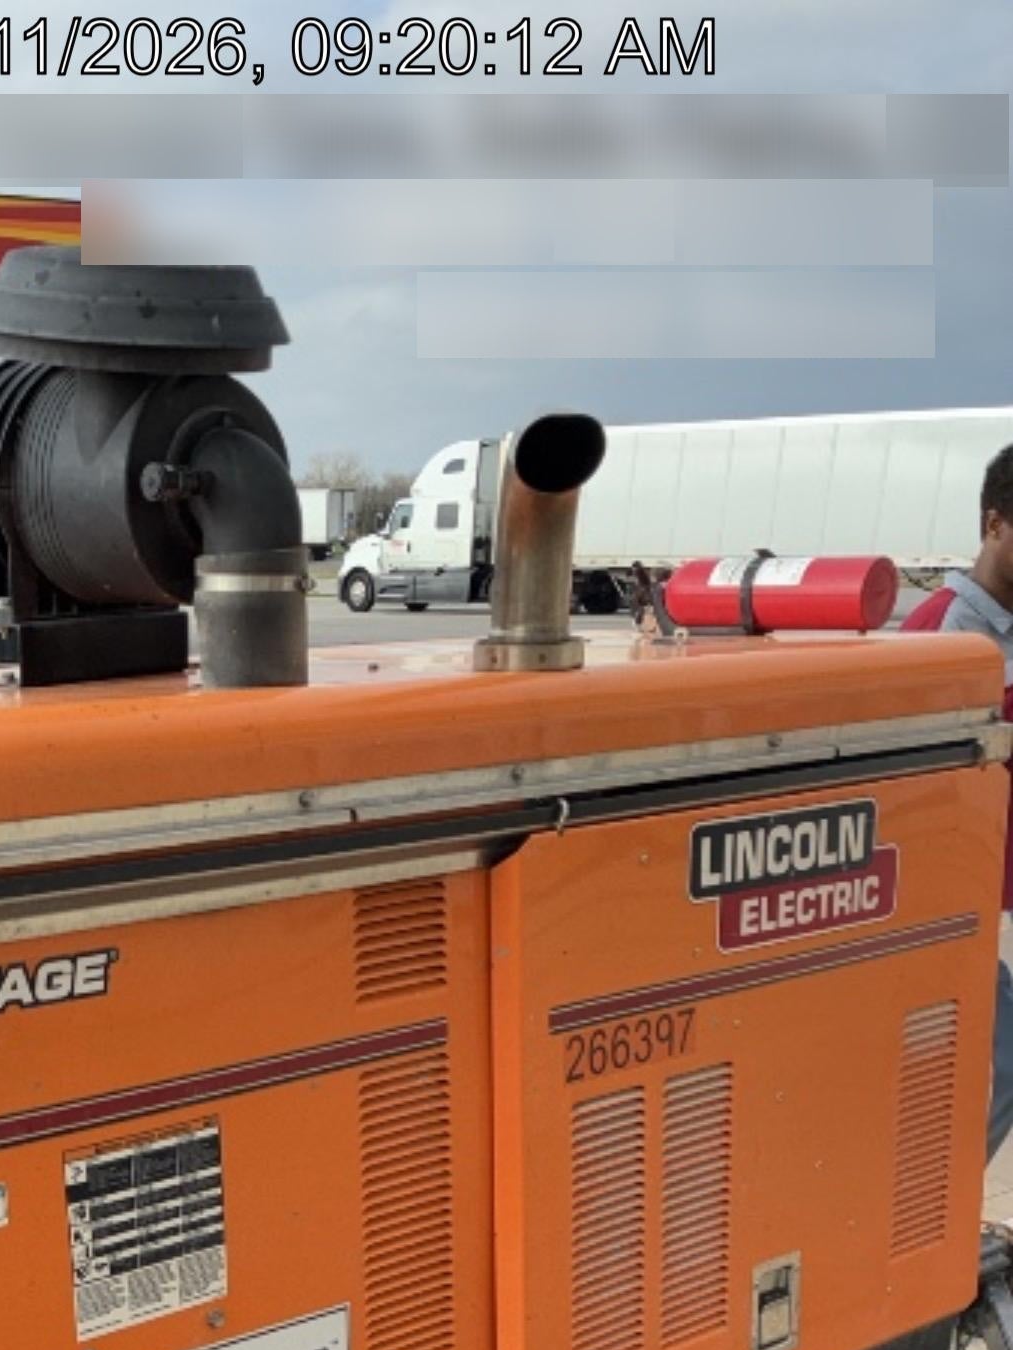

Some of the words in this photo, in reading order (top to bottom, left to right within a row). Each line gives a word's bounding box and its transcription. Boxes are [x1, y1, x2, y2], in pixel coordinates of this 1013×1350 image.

[700, 812, 868, 889] LINCOLN
[739, 875, 880, 937] ELECTRIC
[565, 1007, 696, 1084] 266397
